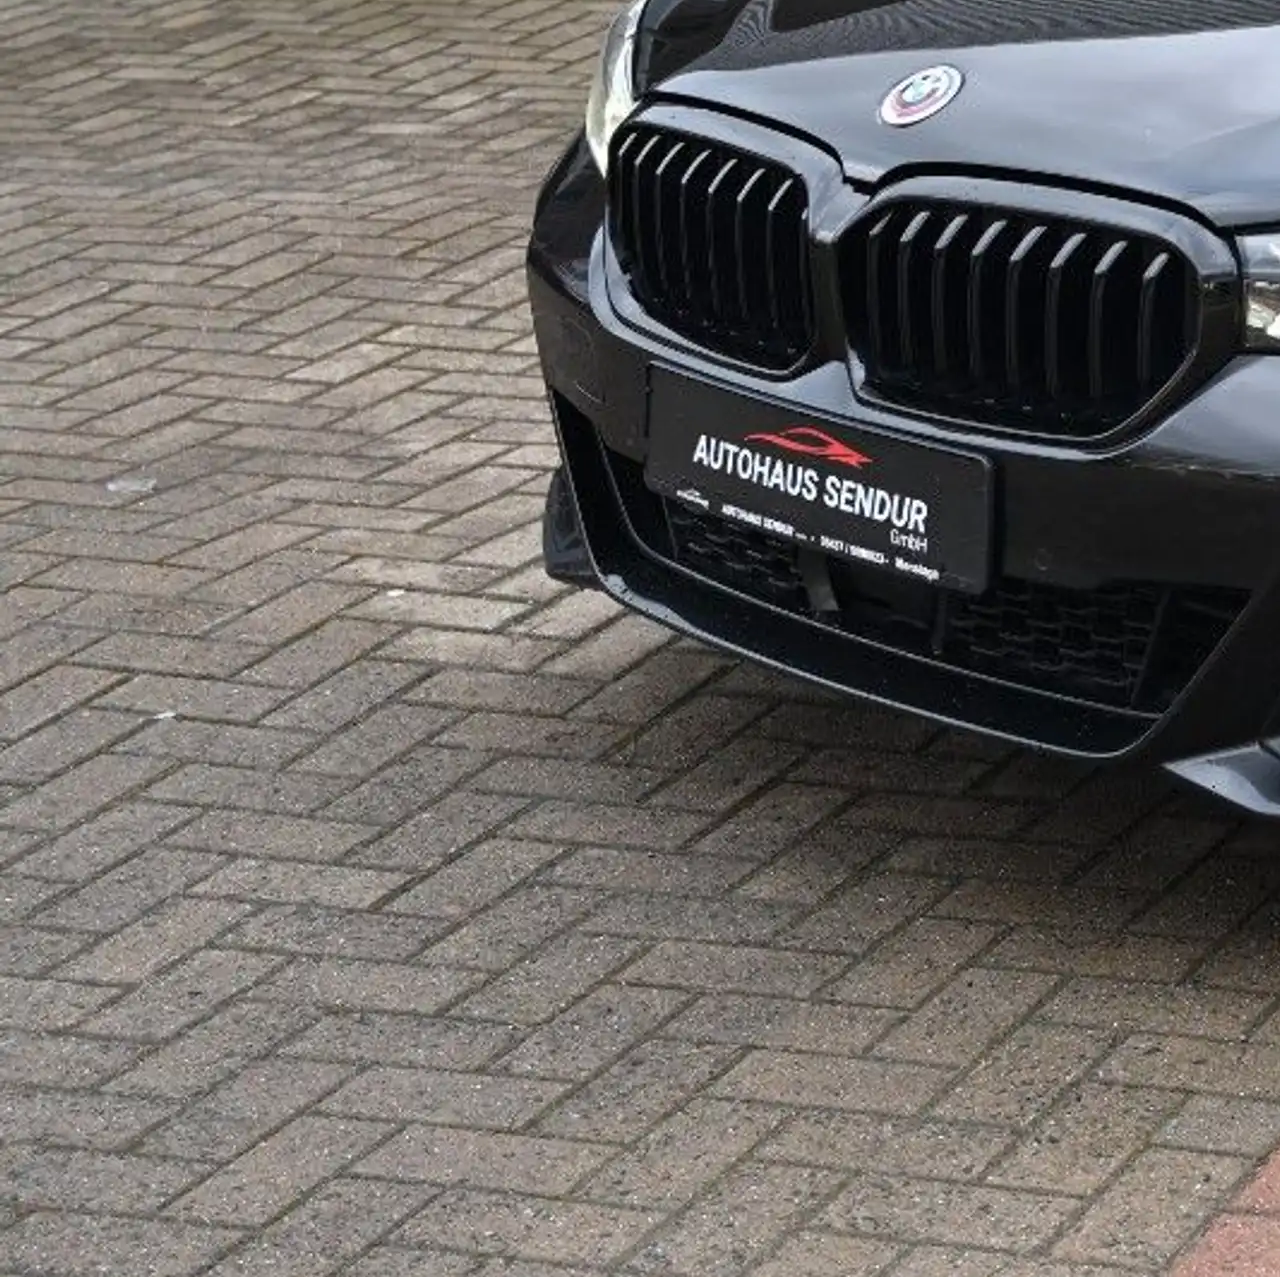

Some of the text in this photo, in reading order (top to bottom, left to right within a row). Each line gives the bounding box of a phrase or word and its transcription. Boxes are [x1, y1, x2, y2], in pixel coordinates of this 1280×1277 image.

[693, 434, 929, 534] AUTOHAUS SENDUR
[889, 528, 928, 553] GmbH
